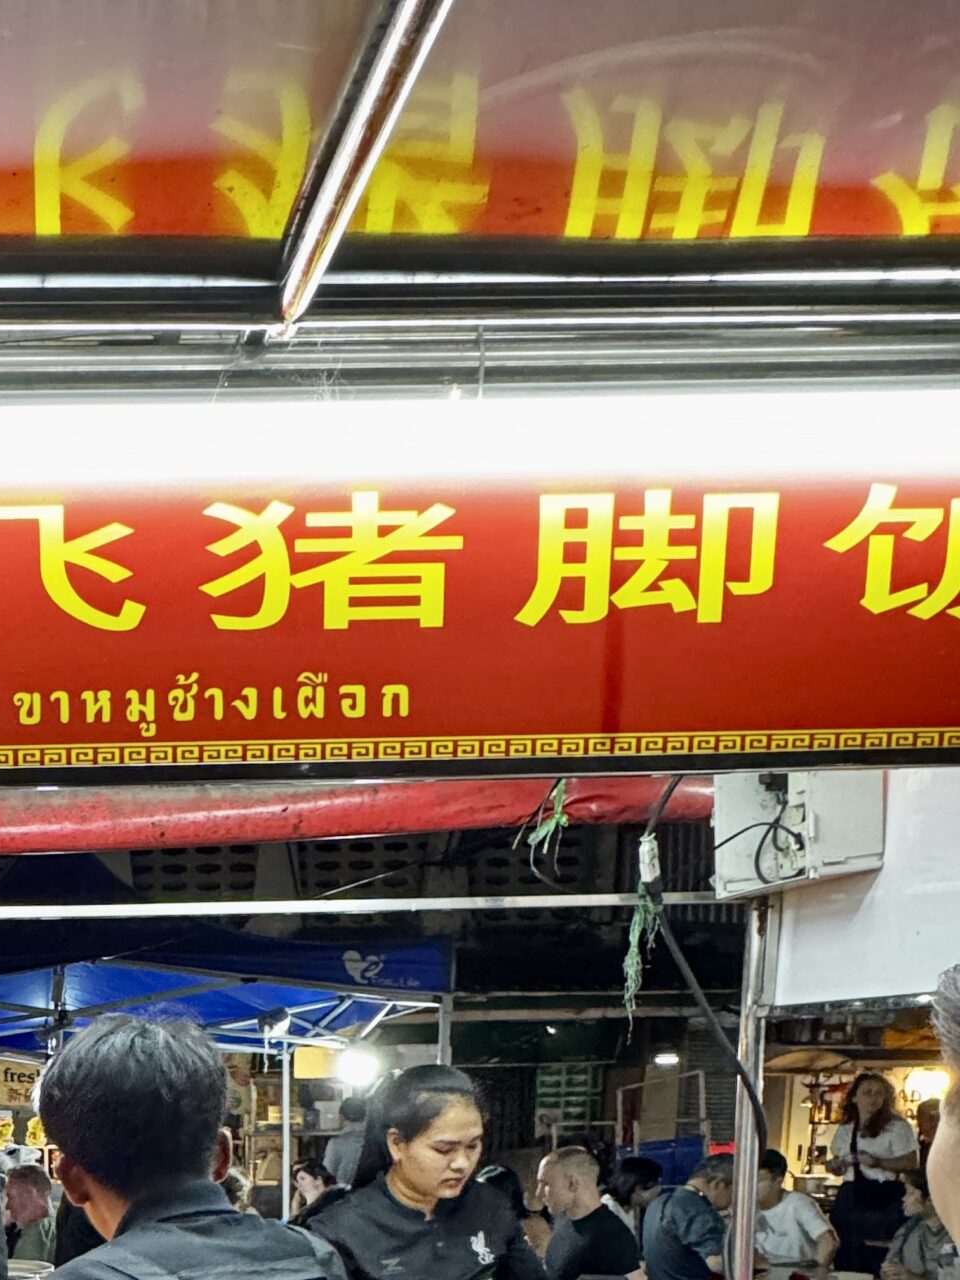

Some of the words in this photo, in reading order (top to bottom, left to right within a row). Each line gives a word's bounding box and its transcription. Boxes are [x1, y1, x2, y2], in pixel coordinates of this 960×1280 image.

[13, 671, 410, 737] ขาหมูช้างเผือก
[3, 1067, 40, 1083] fres
